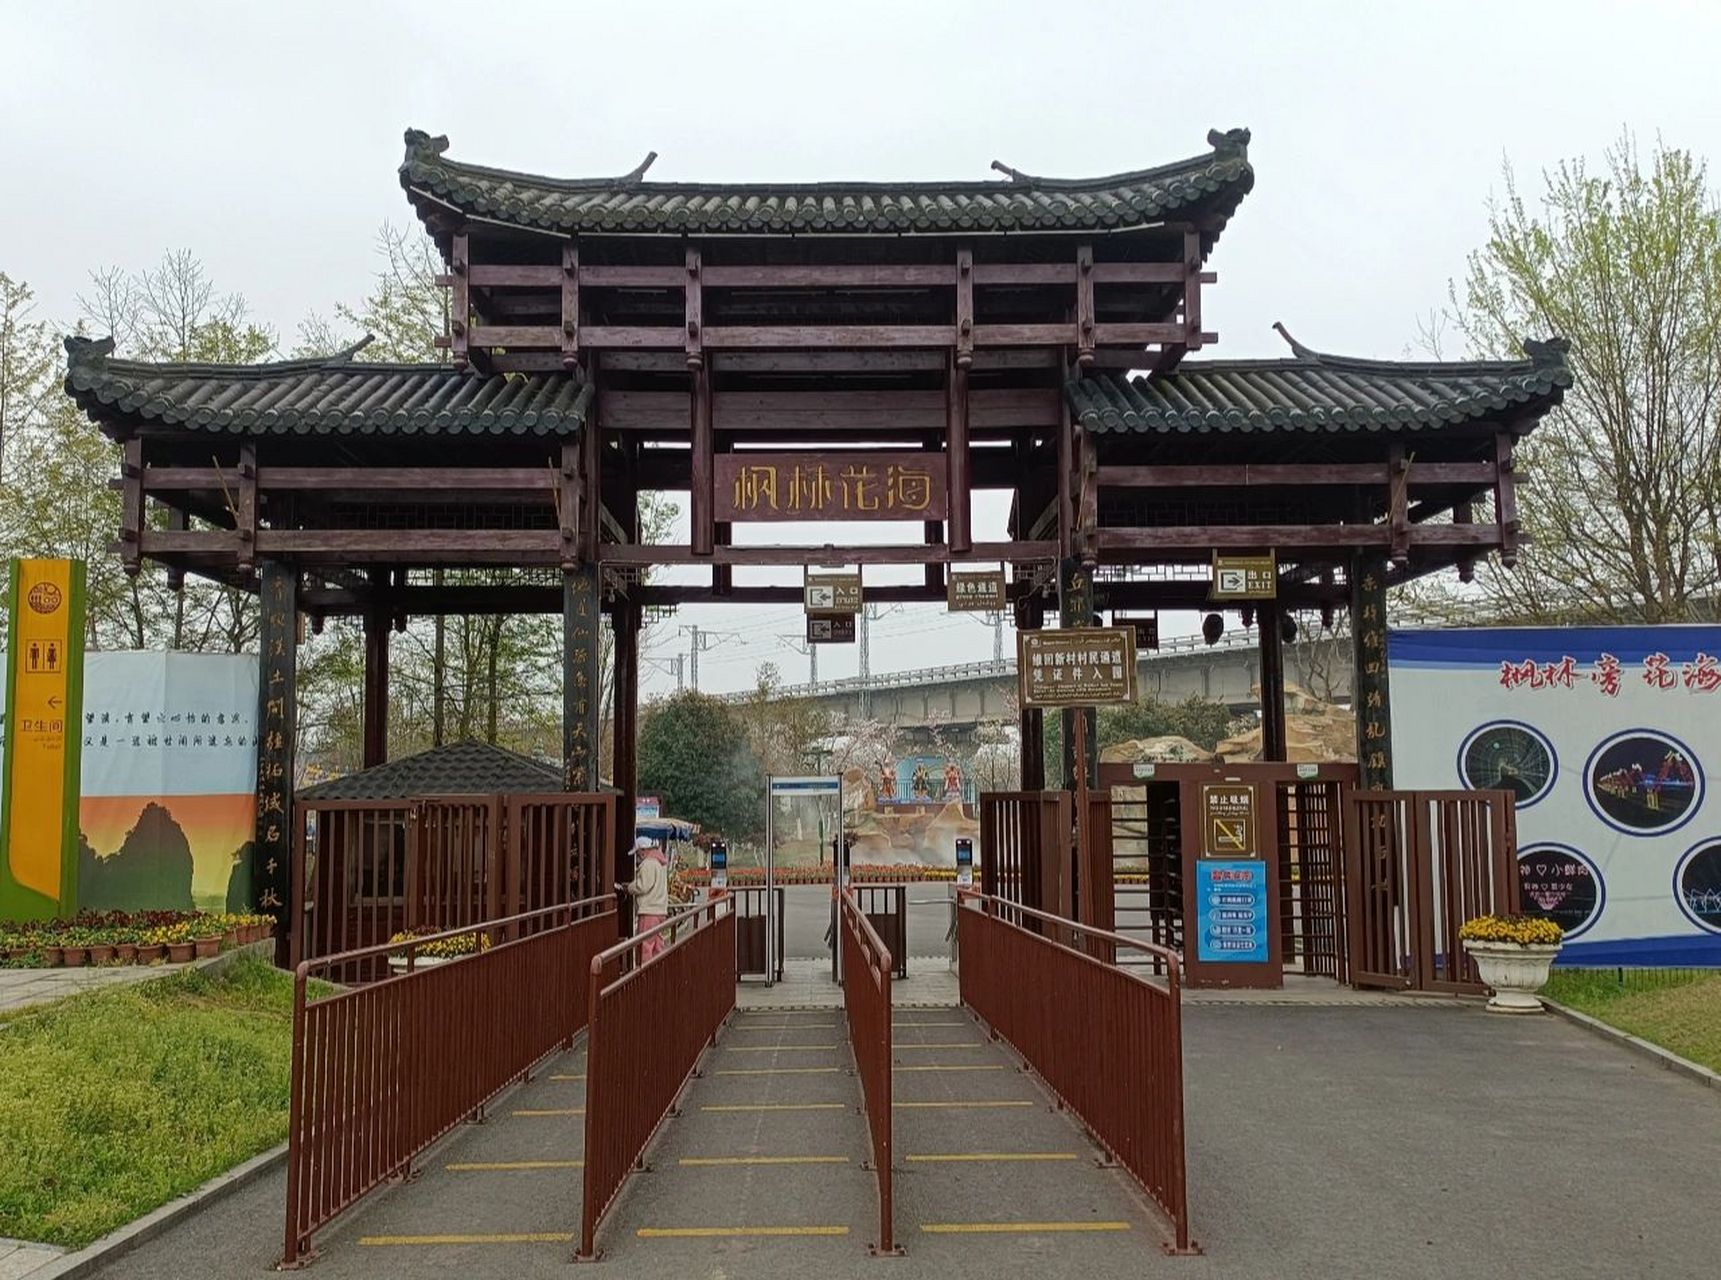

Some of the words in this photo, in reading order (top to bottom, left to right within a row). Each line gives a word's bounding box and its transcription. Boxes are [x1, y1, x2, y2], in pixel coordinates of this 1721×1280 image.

[732, 463, 932, 511] 枫林花海
[1247, 570, 1271, 580] 出口
[1247, 580, 1271, 590] EXIT
[836, 585, 859, 596] 入口
[22, 719, 63, 733] 卫生间
[1210, 795, 1249, 805] 禁止吸烟
